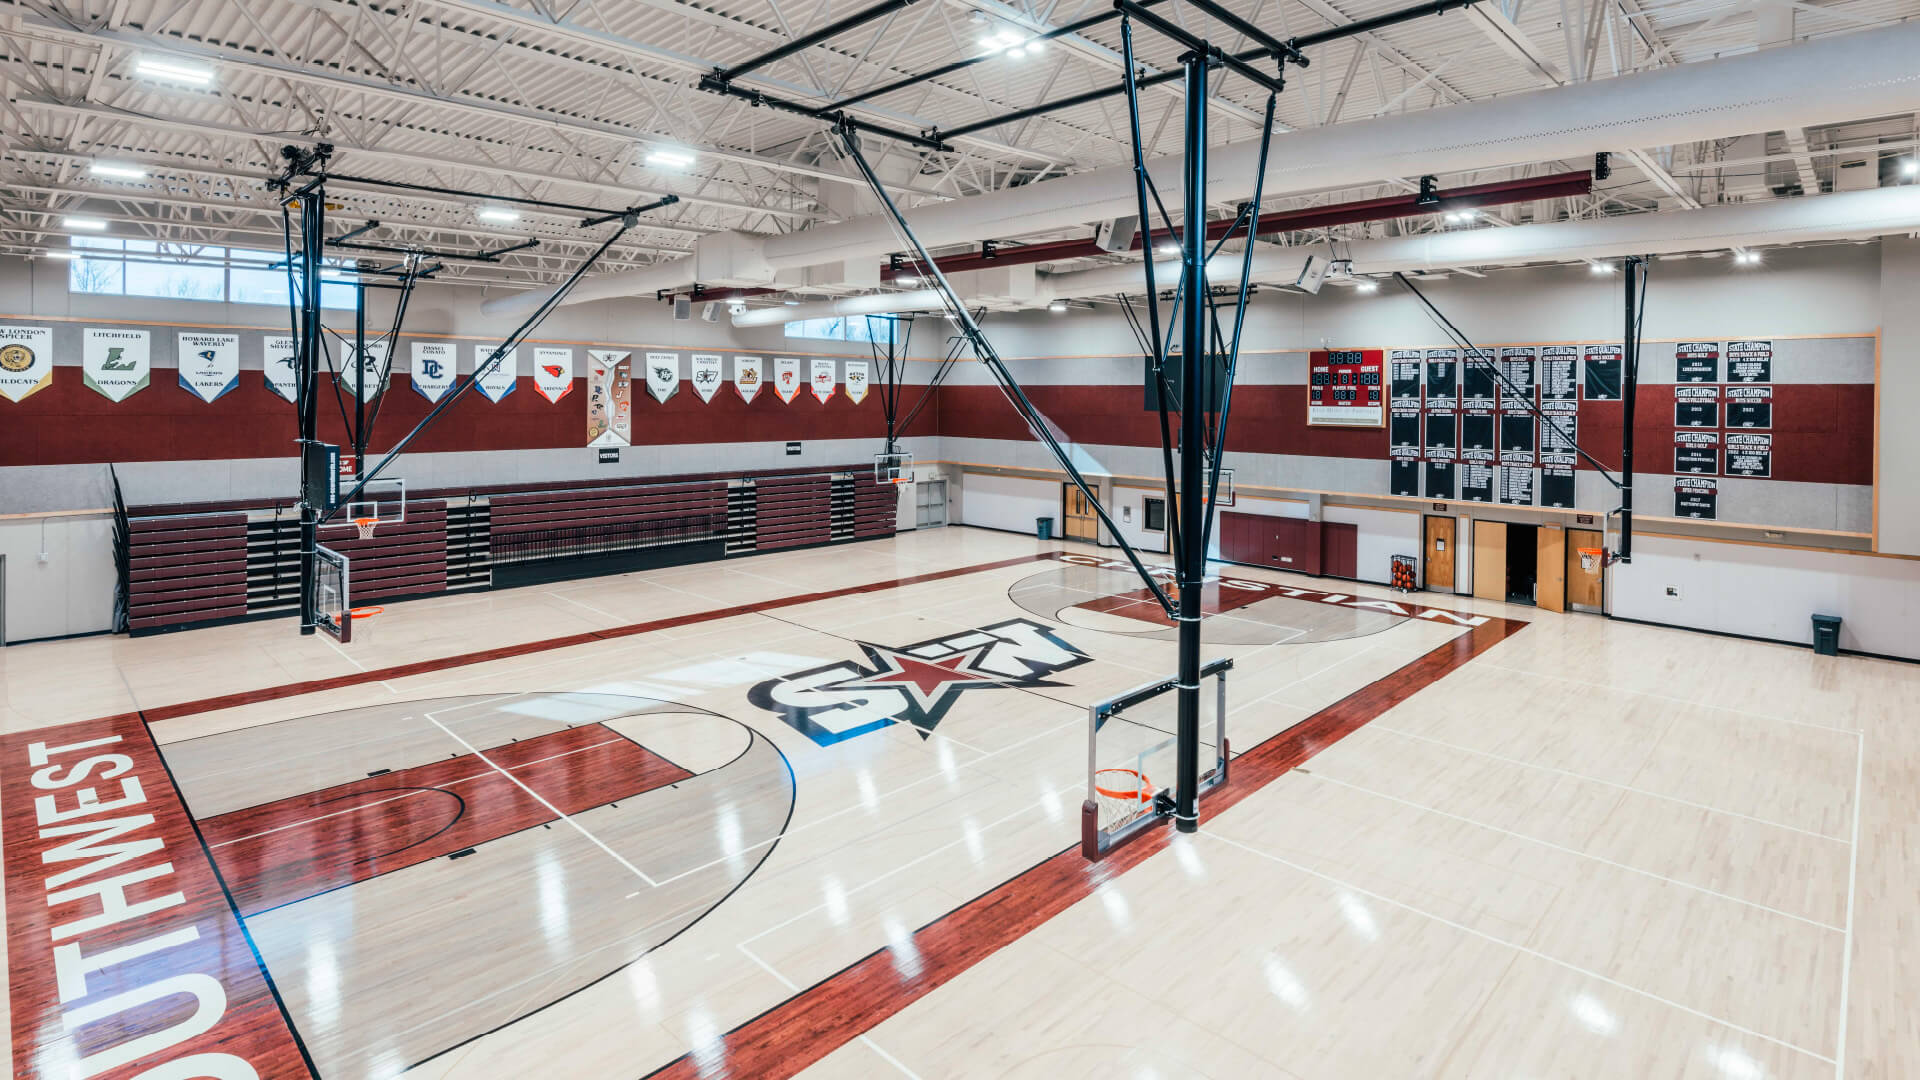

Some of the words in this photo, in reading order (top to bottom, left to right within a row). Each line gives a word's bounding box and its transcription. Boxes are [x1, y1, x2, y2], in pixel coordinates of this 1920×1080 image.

[1678, 344, 1692, 352] STATE
[1692, 343, 1717, 352] CHAMPION
[1729, 343, 1743, 352] STATE
[1744, 342, 1770, 351] CHAMPION
[1677, 389, 1691, 397] STATE
[1692, 388, 1716, 397] CHAMPION
[1728, 389, 1742, 397] STATE
[1743, 388, 1769, 397] CHAMPION
[1677, 434, 1691, 442] STATE
[1692, 433, 1716, 442] CHAMPION
[1728, 436, 1742, 444] STATE
[1743, 435, 1769, 444] CHAMPION
[1691, 478, 1716, 488] CHAMPION
[28, 735, 261, 1080] UTHWEST
